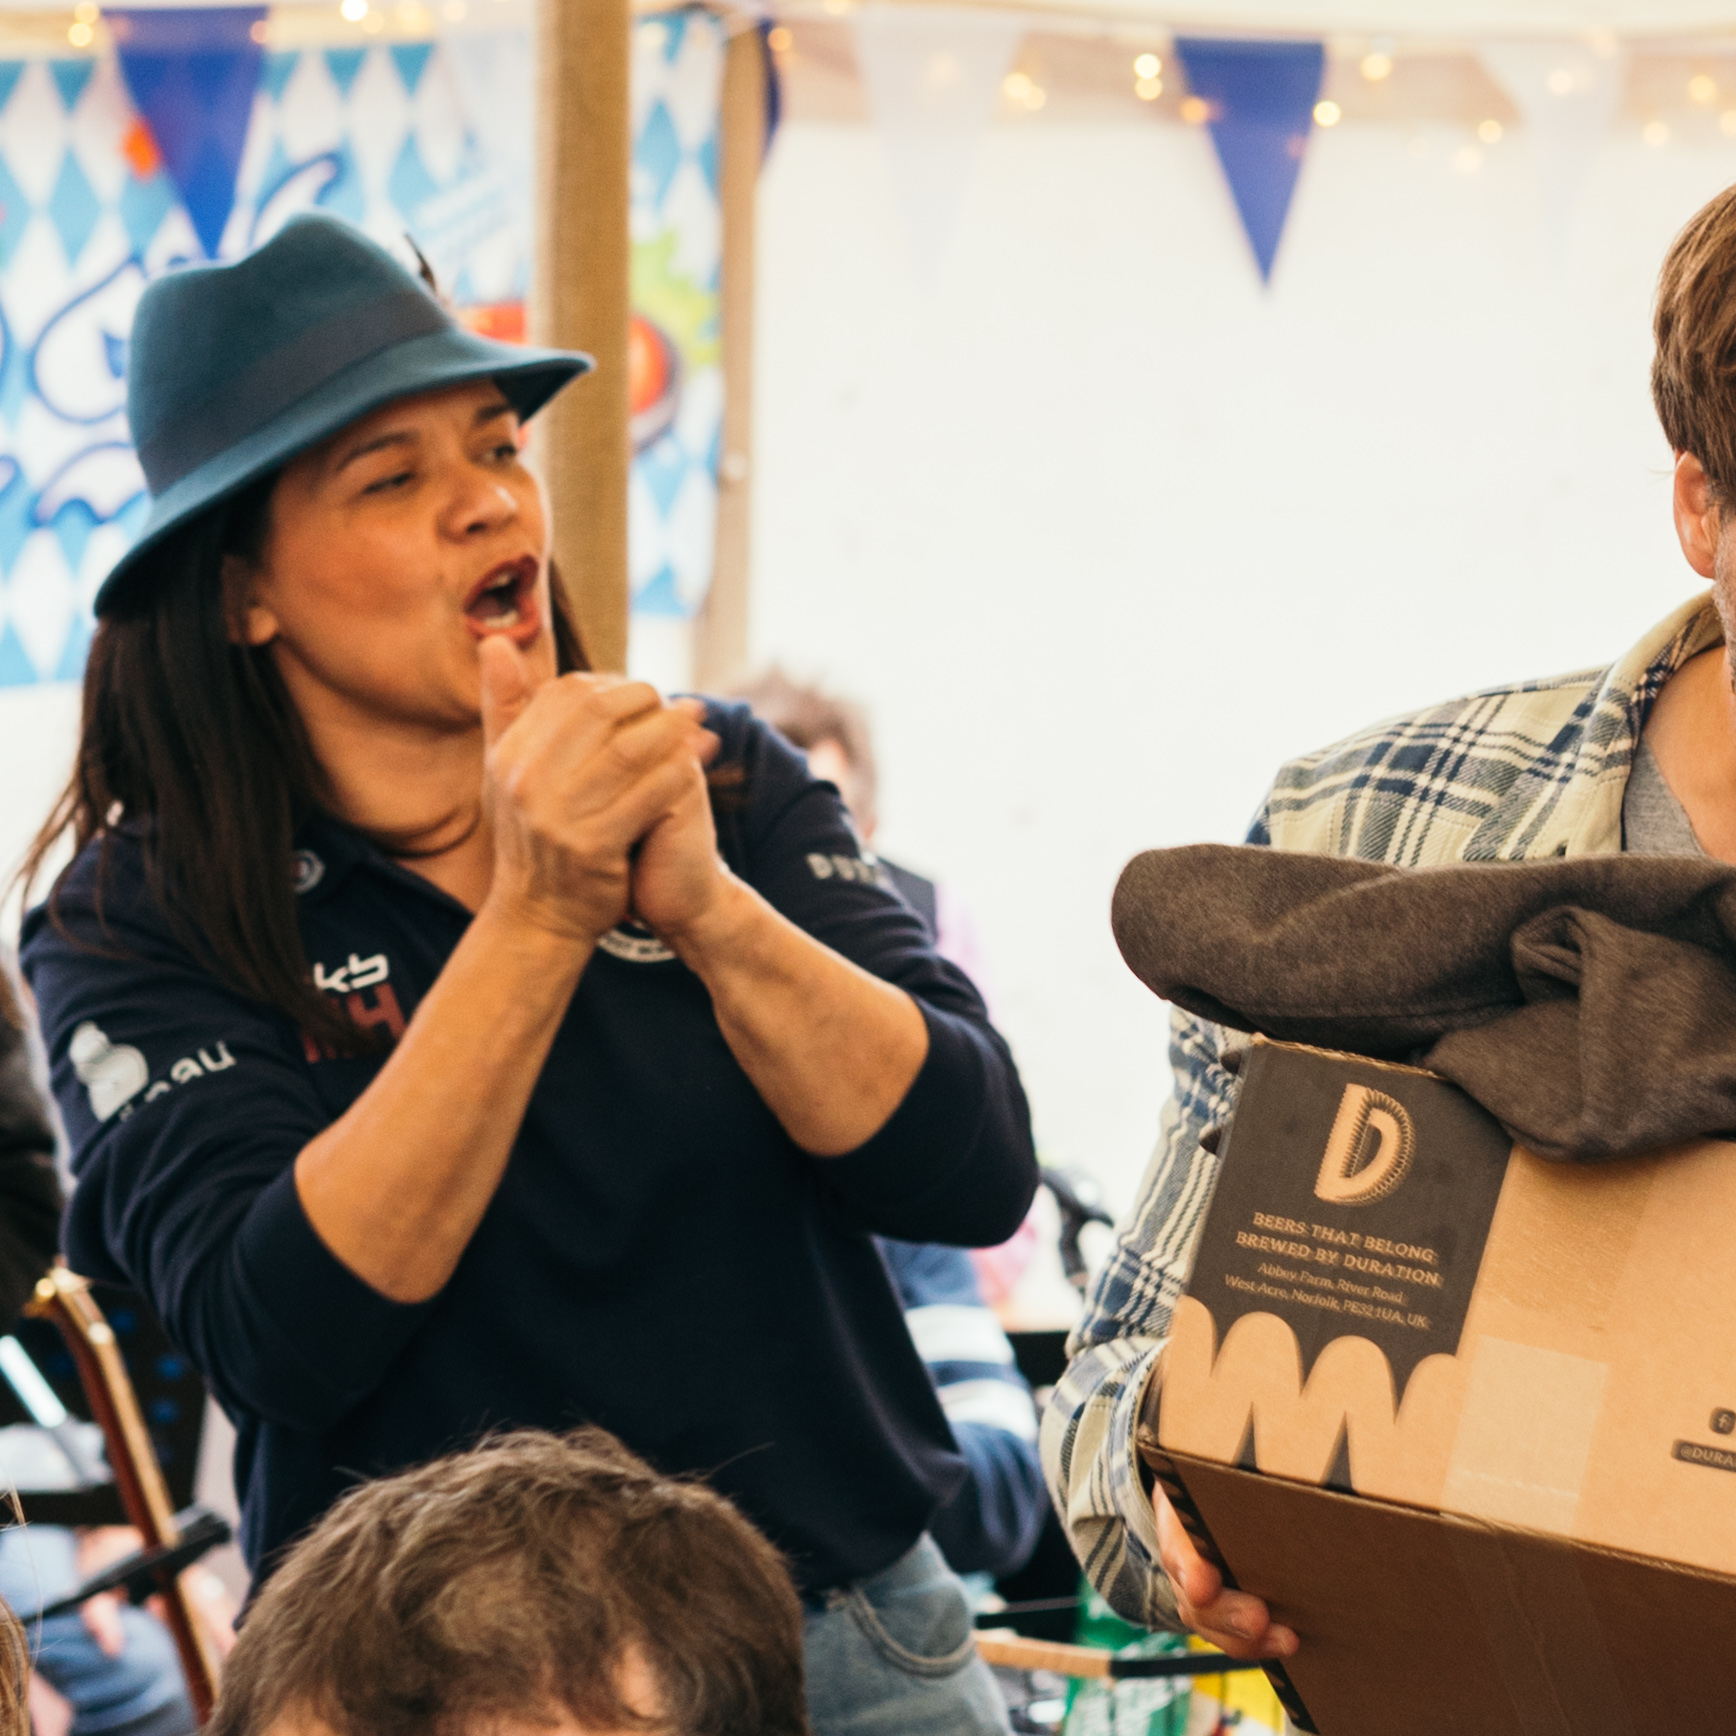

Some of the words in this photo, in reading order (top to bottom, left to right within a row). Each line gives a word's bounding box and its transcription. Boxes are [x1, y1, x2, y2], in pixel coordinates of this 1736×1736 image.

[1236, 1231, 1311, 1260] BREWED
[1315, 1249, 1340, 1264] BY
[1343, 1254, 1442, 1286] DURATION
[1253, 1212, 1306, 1235] BEERS
[1311, 1224, 1360, 1246] THAT
[1363, 1236, 1438, 1263] BELONG
[1225, 1274, 1255, 1291] West
[1407, 1313, 1429, 1329] UK
[1257, 1263, 1297, 1282] Abbey
[1337, 1278, 1370, 1296] River
